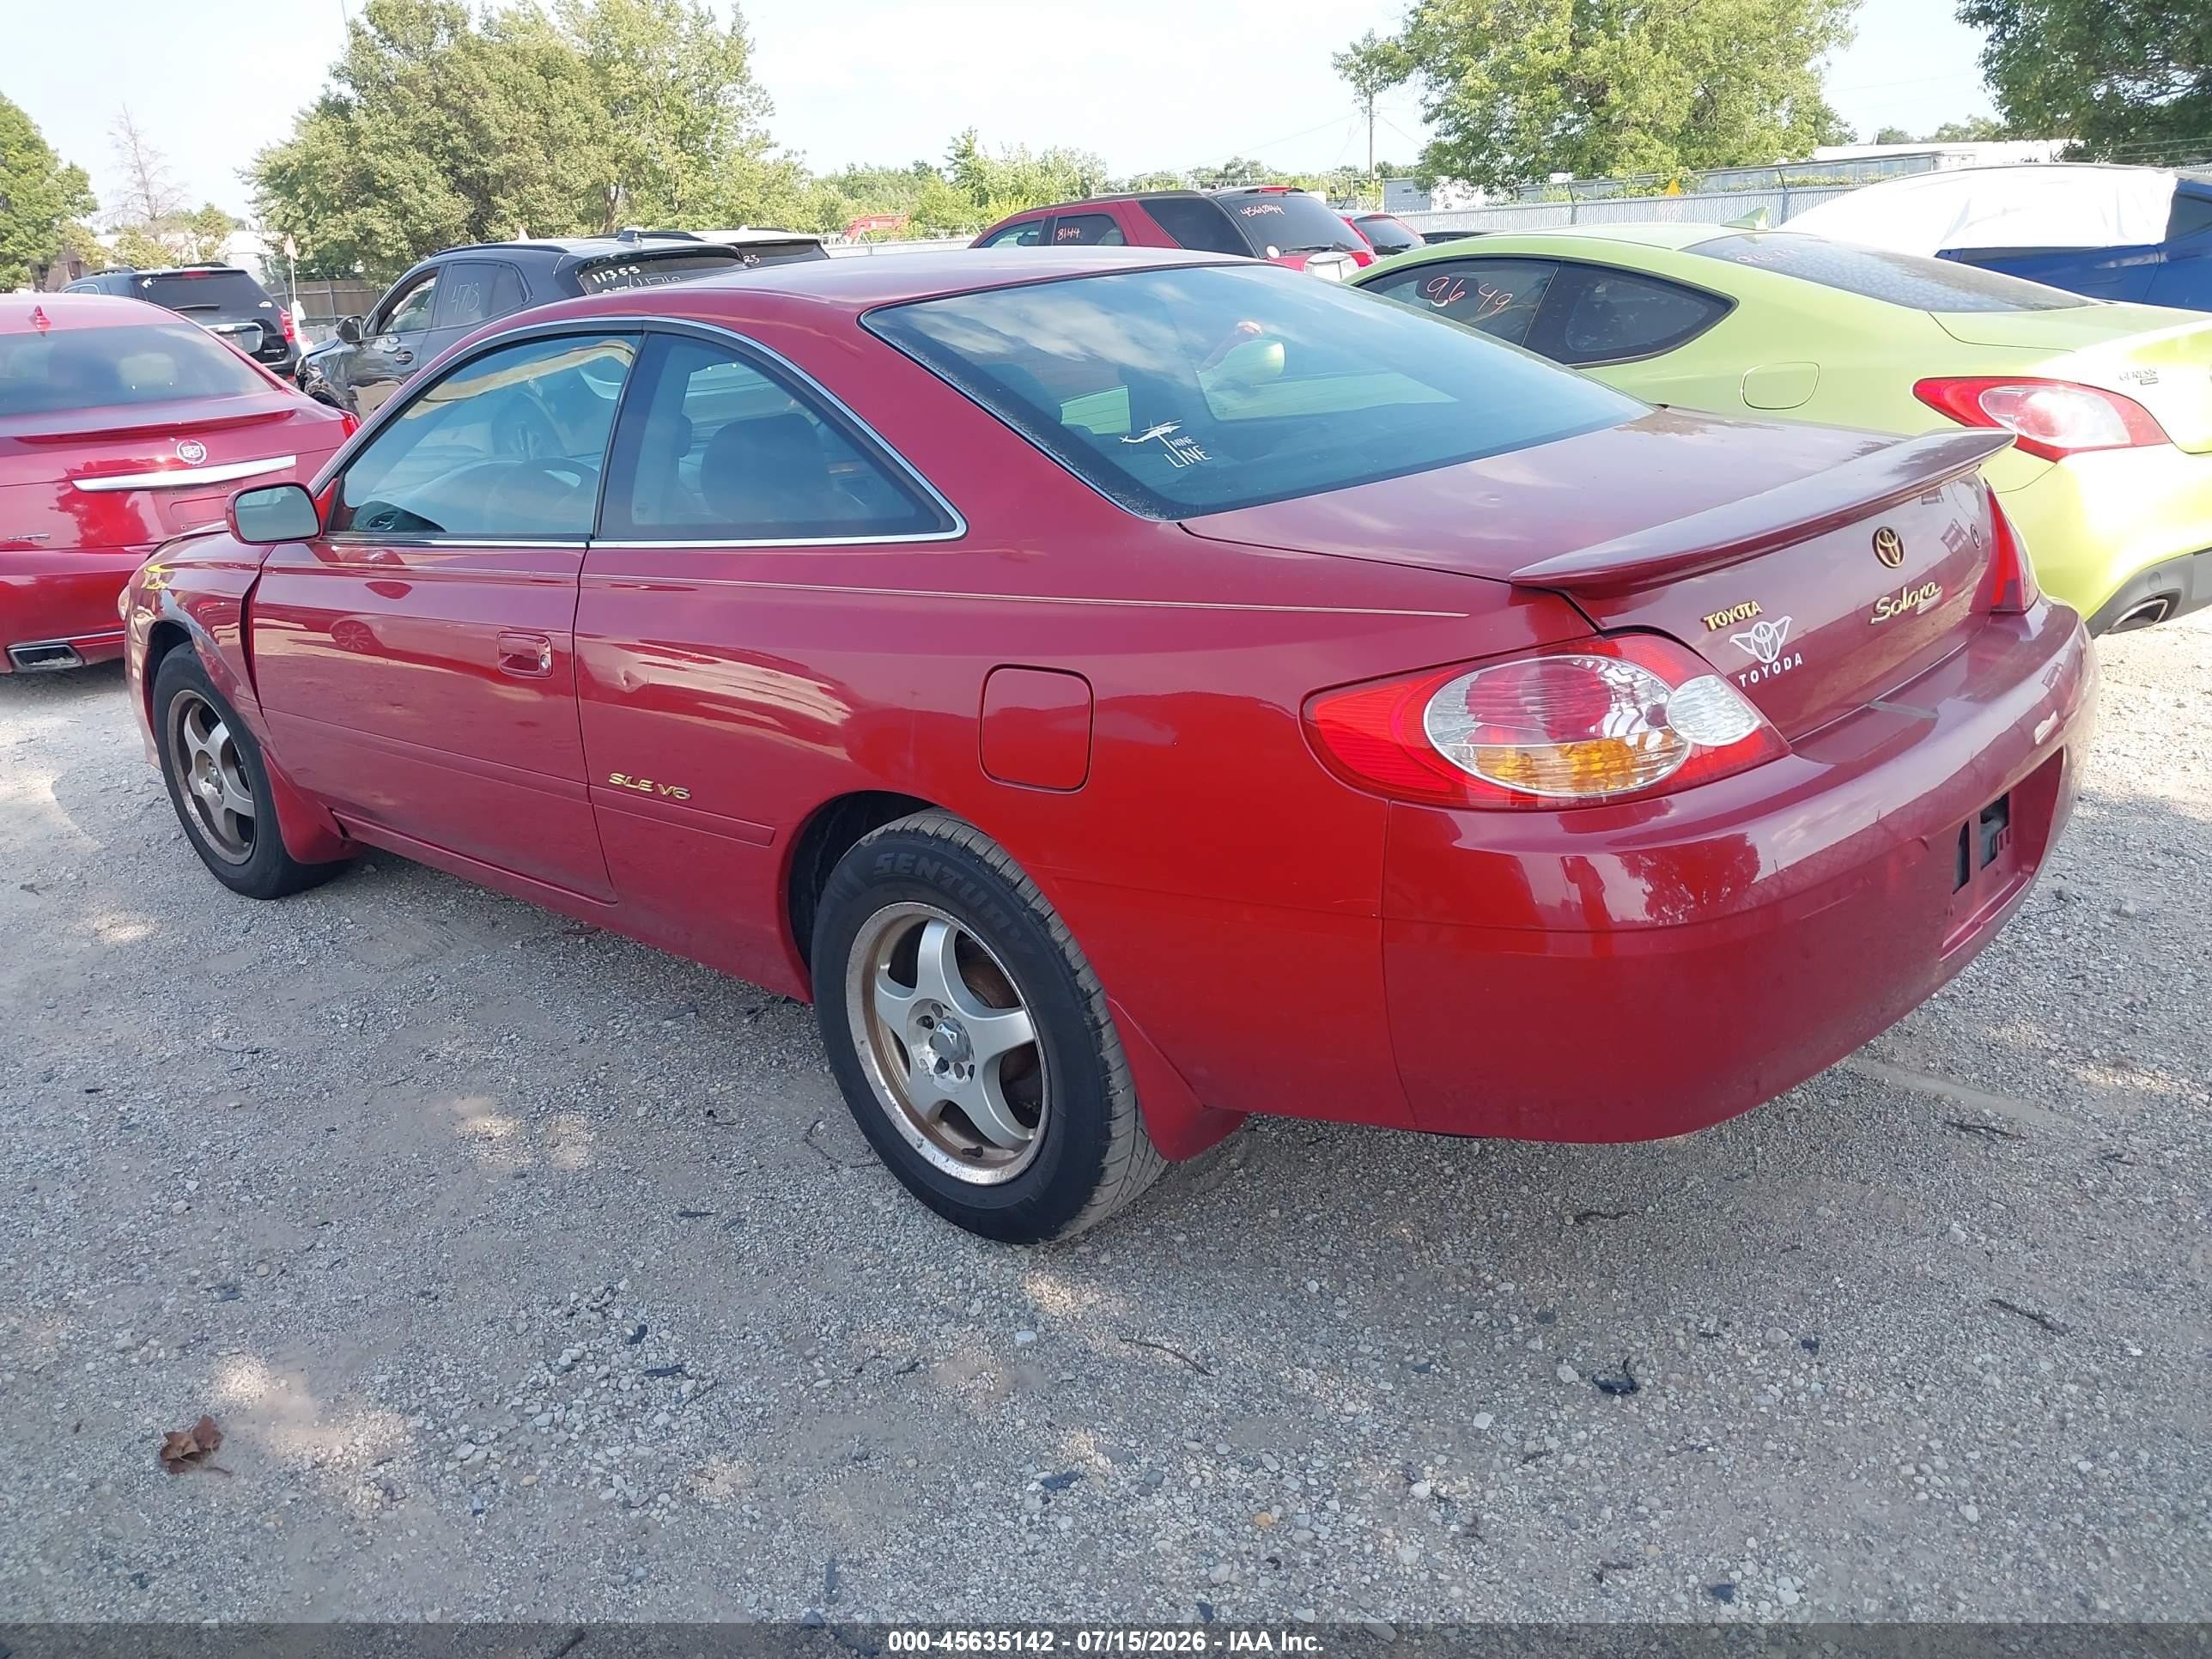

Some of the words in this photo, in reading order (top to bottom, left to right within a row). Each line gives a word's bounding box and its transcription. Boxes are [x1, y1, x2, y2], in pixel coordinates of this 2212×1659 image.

[1057, 228, 1080, 240] 8144
[1169, 435, 1196, 448] NINE
[1164, 445, 1212, 468] LINE
[1702, 600, 1764, 631] TOYOTA
[1869, 581, 1942, 625] Solara
[1738, 653, 1803, 688] TOYODA
[608, 772, 653, 793] SLE
[657, 783, 691, 800] V6
